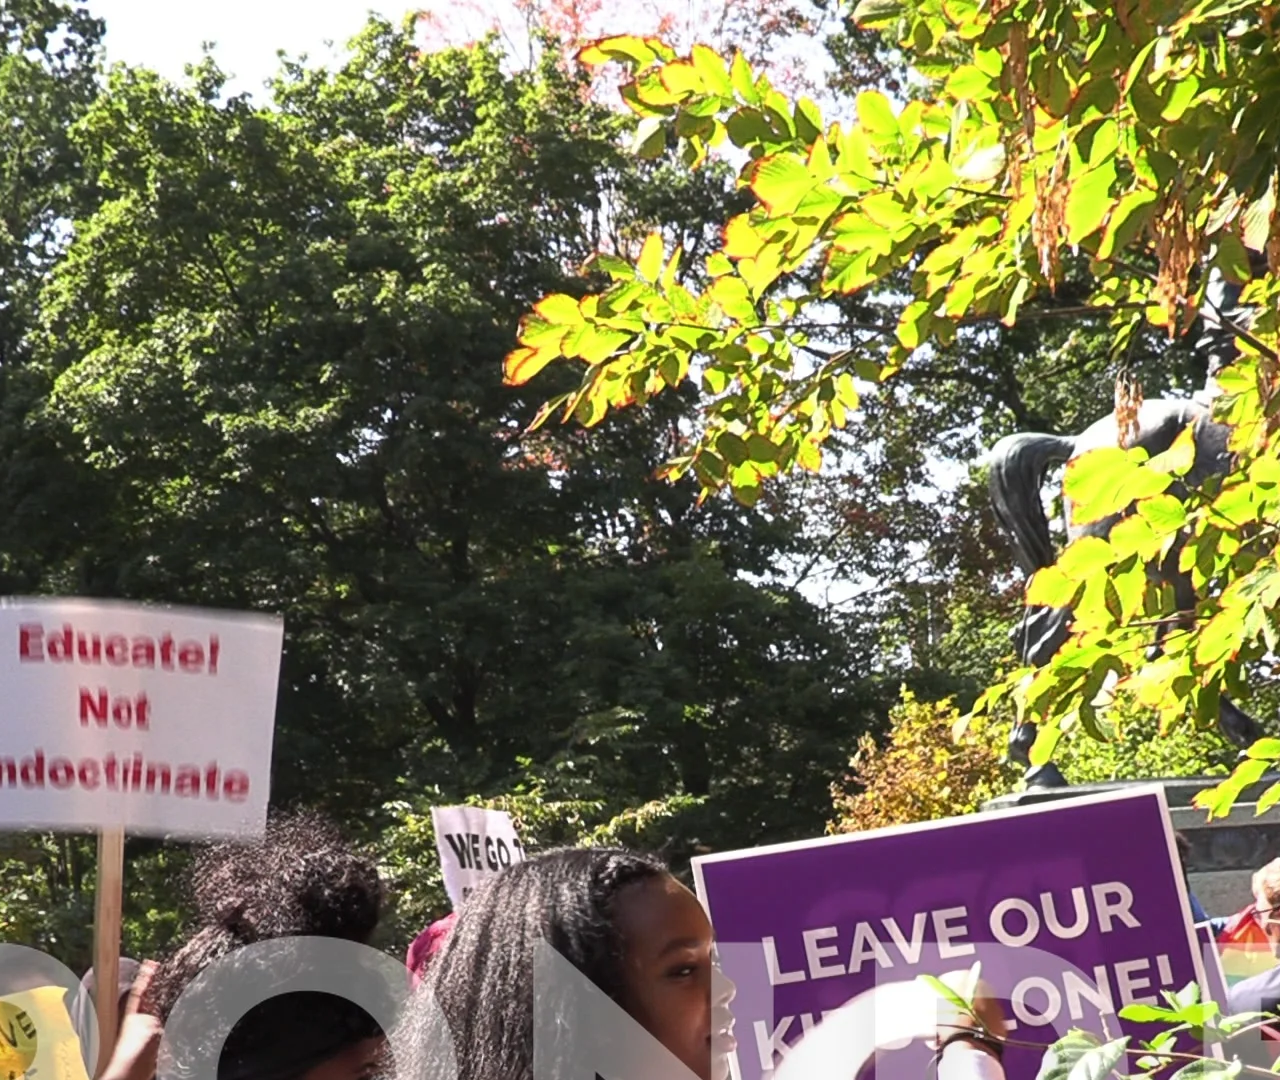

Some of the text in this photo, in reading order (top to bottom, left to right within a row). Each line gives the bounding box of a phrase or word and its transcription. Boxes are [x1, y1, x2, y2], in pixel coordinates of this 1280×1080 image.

[19, 622, 219, 676] Educate!
[79, 686, 151, 731] Not
[444, 832, 483, 871] WE
[485, 835, 511, 873] GO
[761, 881, 1141, 987] LEAVE OUR
